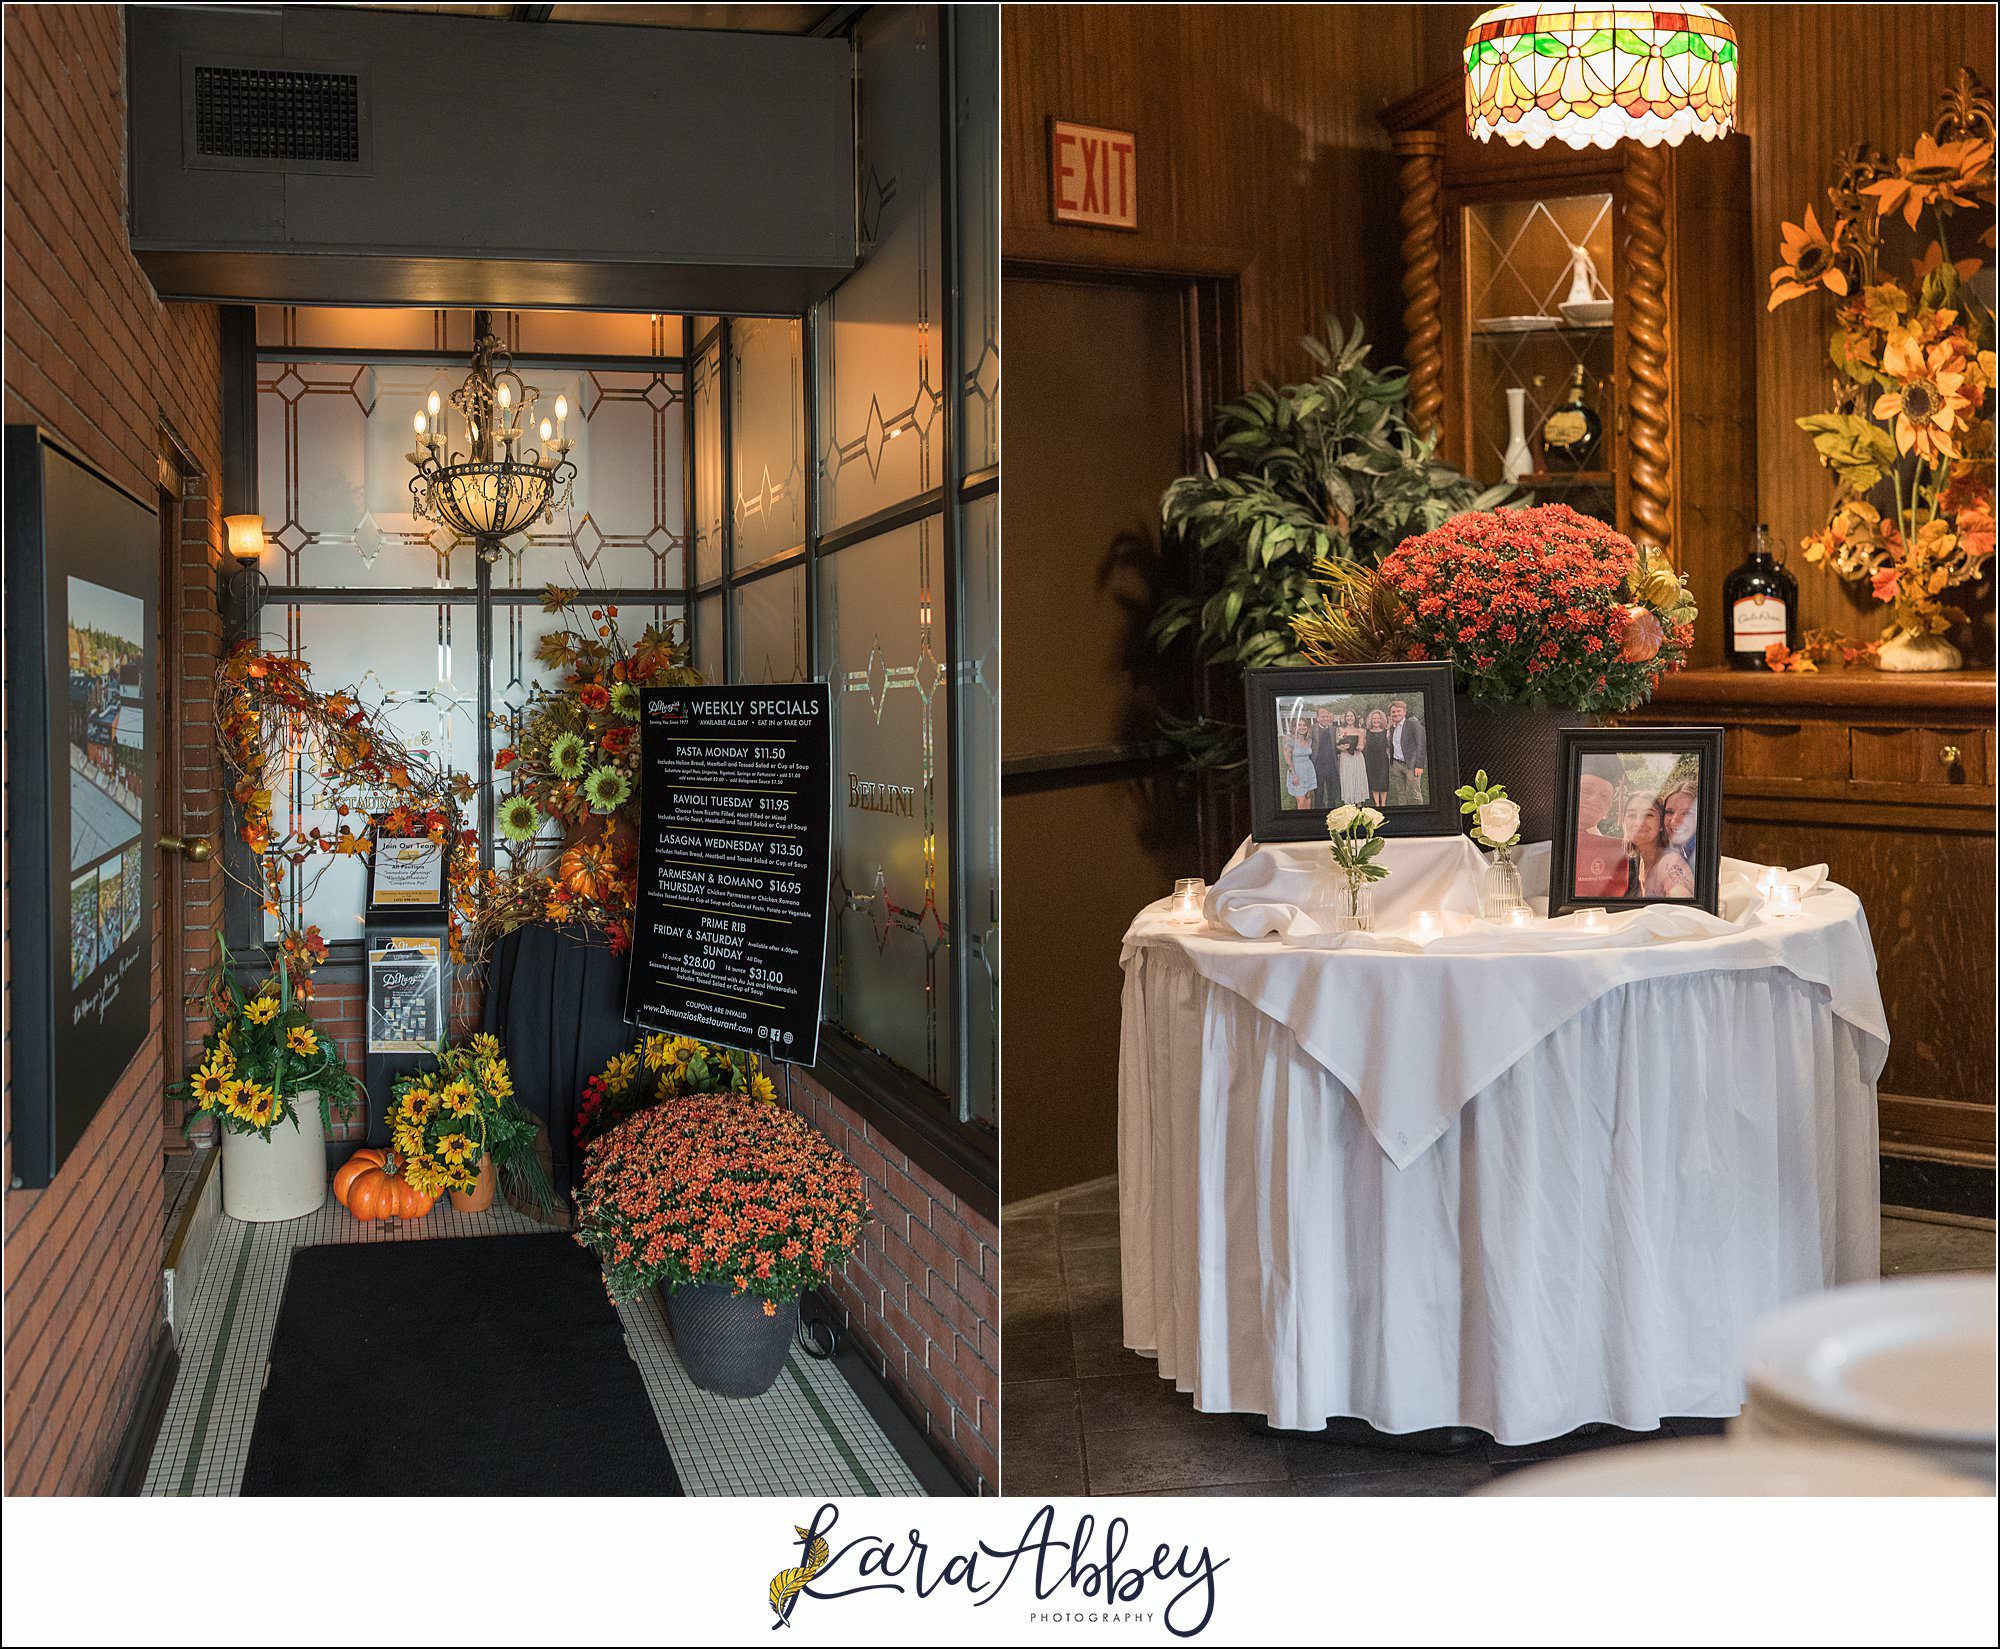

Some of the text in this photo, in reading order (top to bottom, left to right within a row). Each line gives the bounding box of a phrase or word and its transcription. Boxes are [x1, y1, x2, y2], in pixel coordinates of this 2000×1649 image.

[1055, 133, 1133, 217] EXIT
[690, 699, 819, 715] WEEKLY SPECIALS
[676, 746, 785, 759] PASTA MONDAY $11.50
[673, 794, 788, 810] RAVIOLI TUESDAY $11.95
[848, 772, 914, 818] BELLINI
[383, 842, 396, 851] Join
[659, 833, 803, 856] LASAGNA WEDNESDAY $13.50
[775, 859, 786, 867] Cup
[658, 867, 801, 894] PARMESAN & ROMANO $16.95
[658, 879, 705, 895] THURSDAY
[706, 888, 725, 896] Chicken
[726, 891, 749, 899] Parmesan
[757, 895, 777, 903] Chicken
[653, 923, 683, 938] FRIDAY
[686, 929, 693, 939] &
[695, 930, 744, 948] SATURDAY
[701, 916, 746, 933] PRIME RIB
[702, 944, 742, 961] SUNDAY
[648, 961, 669, 970] Seasoned
[691, 969, 709, 978] Roasted
[710, 973, 726, 981] served
[755, 981, 765, 989] and
[766, 983, 797, 995] Horseradish
[682, 954, 715, 971] $28.00
[748, 966, 782, 984] $31.00
[676, 973, 694, 982] Includes
[695, 977, 711, 985] Tossed
[712, 980, 725, 988] Salad
[732, 984, 743, 992] Cup
[750, 987, 763, 996] Soup
[685, 1000, 747, 1019] COUPONS ARE INVALID
